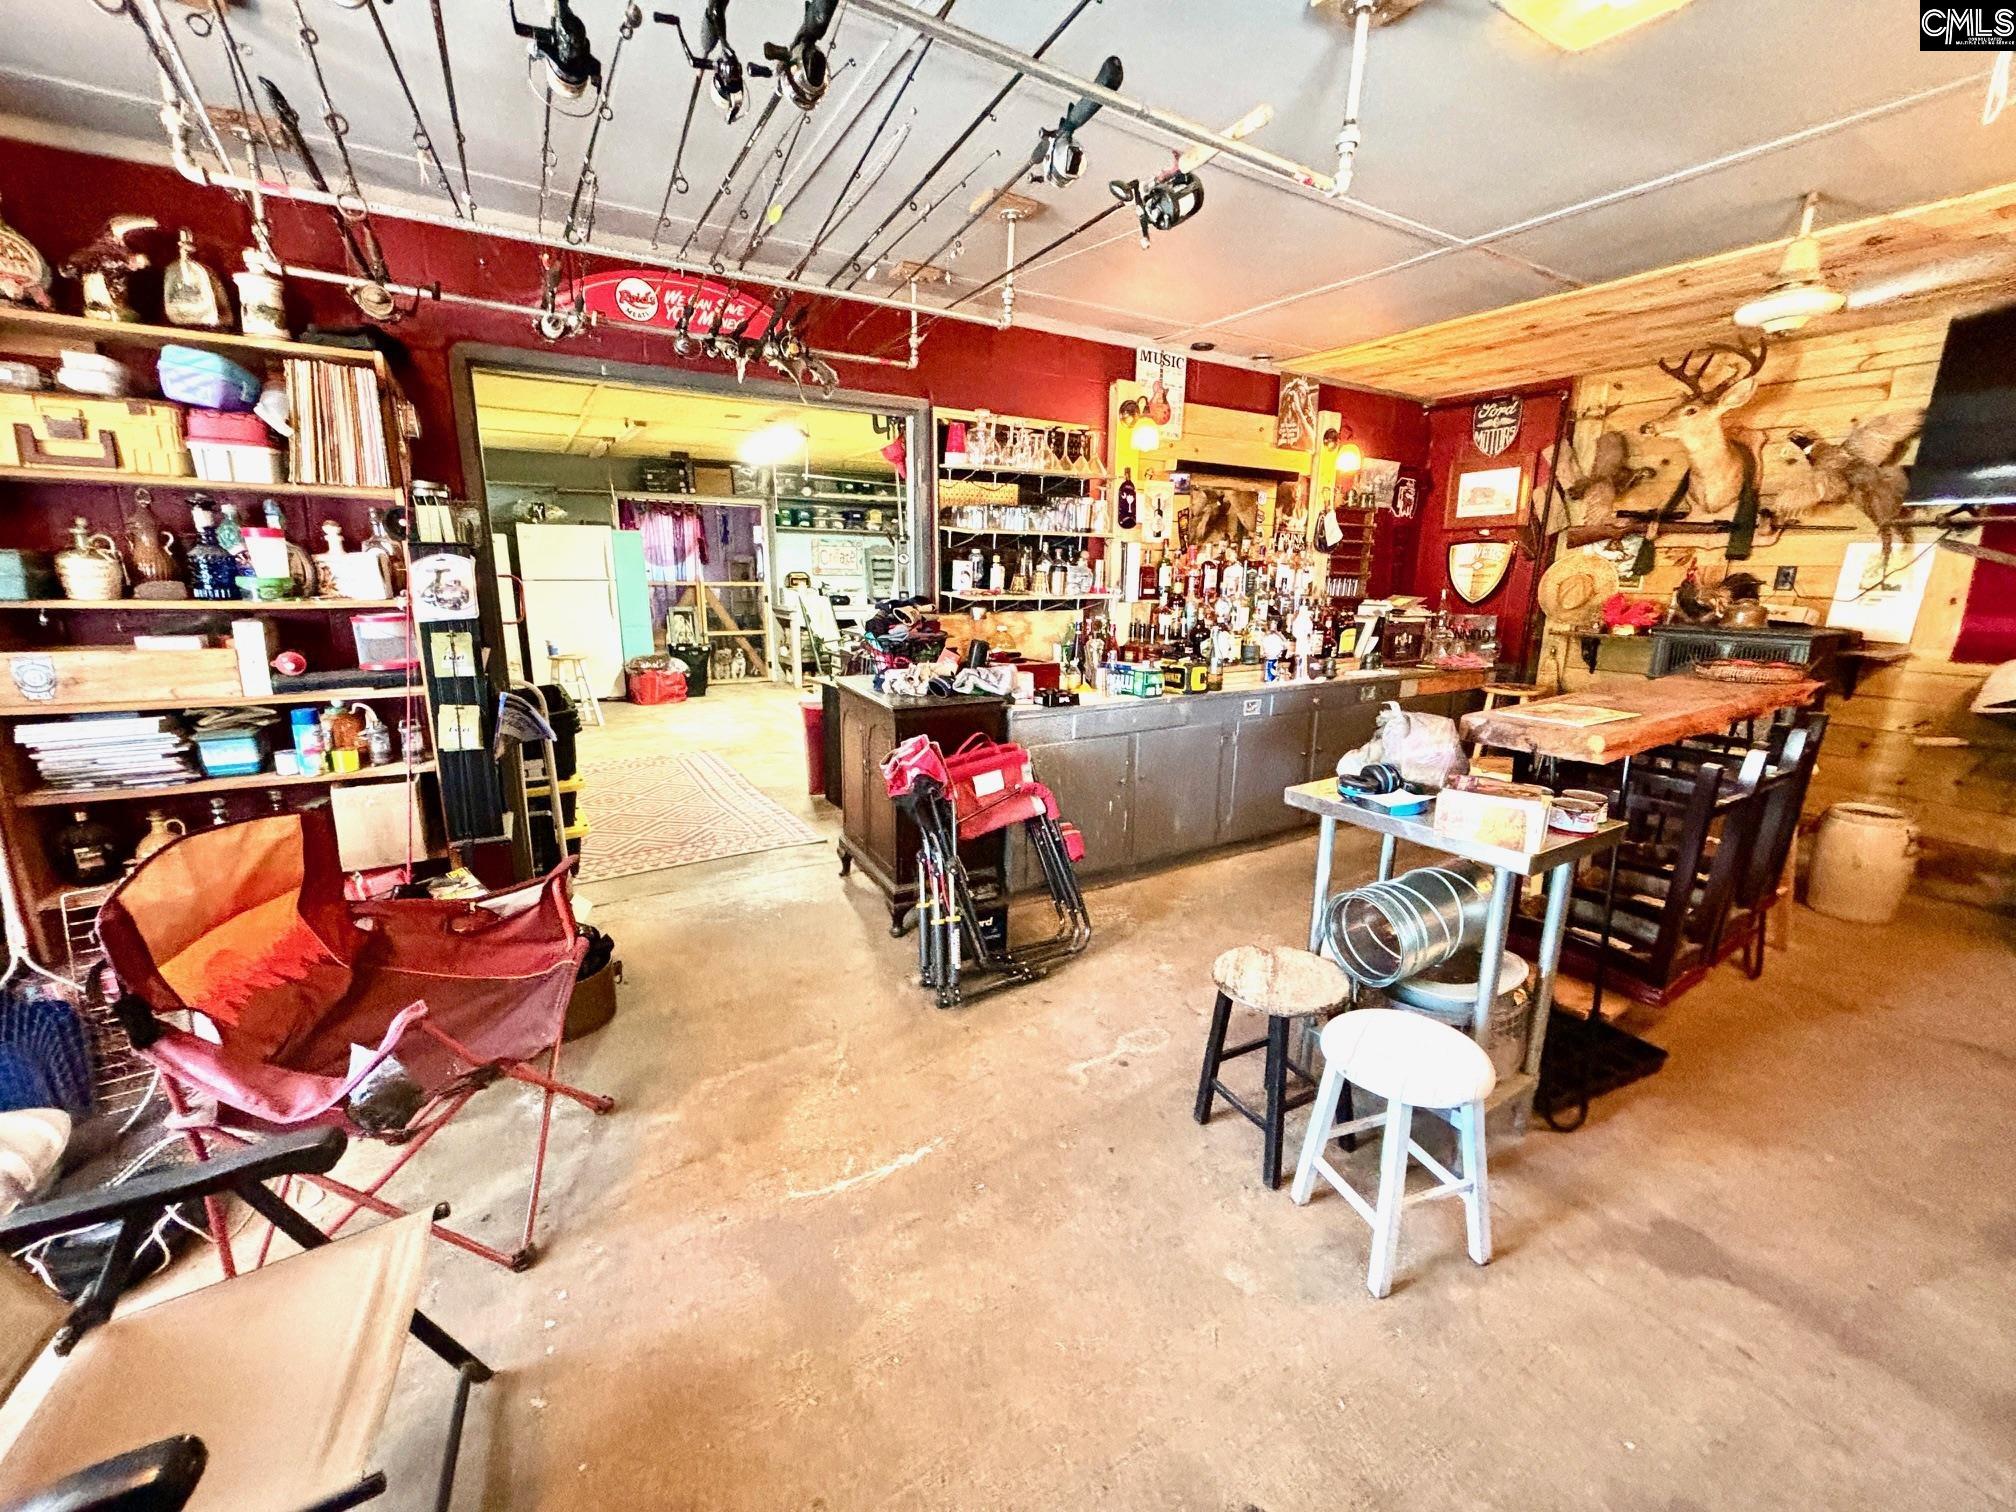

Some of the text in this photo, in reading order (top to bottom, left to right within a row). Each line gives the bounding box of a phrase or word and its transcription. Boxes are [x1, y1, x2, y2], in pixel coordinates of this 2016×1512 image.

[664, 290, 686, 303] WE
[1140, 349, 1185, 370] MUSIC
[1478, 401, 1519, 419] Ford
[1278, 532, 1306, 545] DRINK
